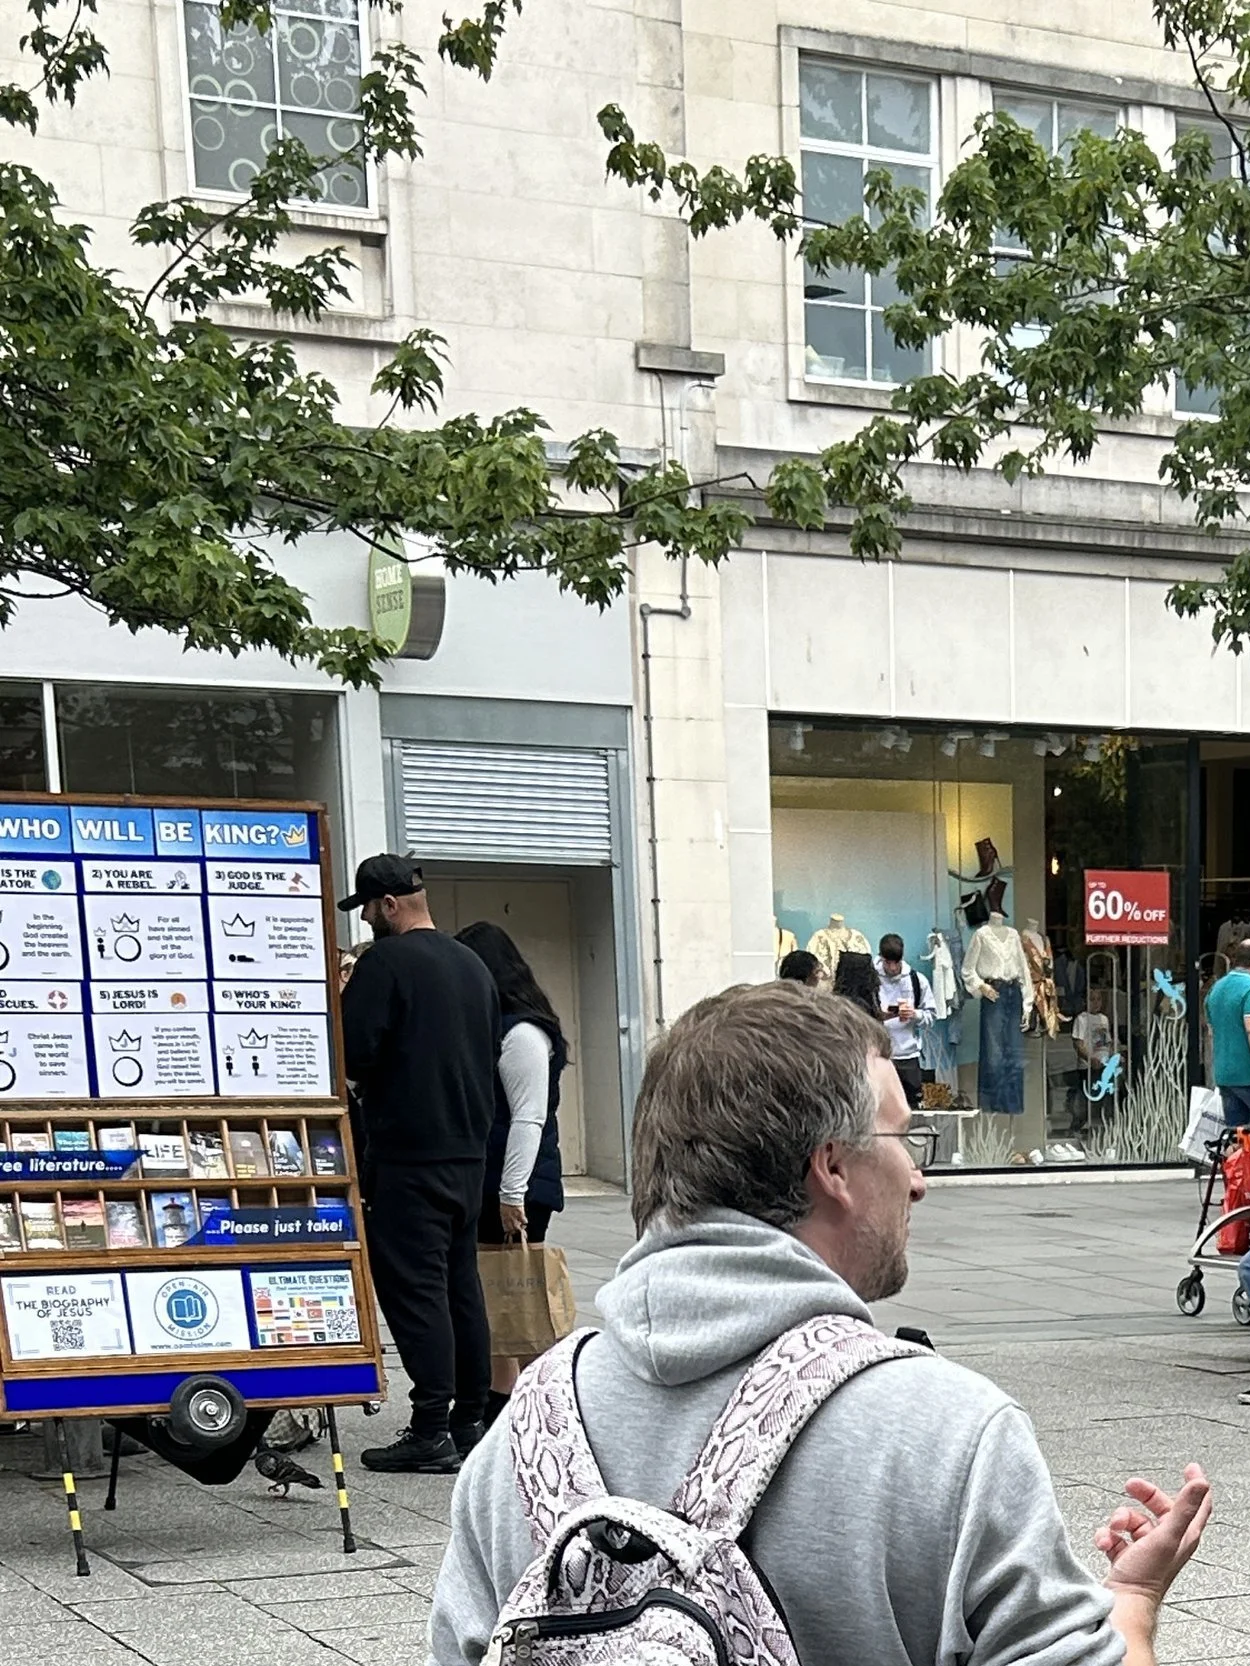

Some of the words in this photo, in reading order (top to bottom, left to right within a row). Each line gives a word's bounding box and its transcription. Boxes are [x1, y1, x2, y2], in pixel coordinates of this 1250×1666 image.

[0, 818, 61, 839] WHO
[76, 819, 144, 841] WILL
[159, 822, 194, 842] BE
[205, 823, 281, 845] KING?
[1, 869, 12, 878] IS
[14, 869, 37, 878] THE
[104, 870, 128, 879] YOU
[130, 870, 153, 879] ARE
[227, 871, 250, 880] GOD
[252, 871, 263, 880] IS
[264, 872, 286, 881] THE
[106, 881, 113, 889] A
[117, 880, 156, 889] REBEL.
[228, 882, 265, 890] JUDGE.
[1088, 890, 1142, 921] 60%
[1143, 910, 1166, 921] OFF
[112, 990, 146, 999] JESUS
[148, 989, 158, 998] IS
[234, 990, 270, 999] WHO'S
[237, 1001, 266, 1009] YOUR
[270, 1000, 302, 1009] KING?
[144, 1144, 185, 1159] LIFE
[274, 1218, 302, 1237] just
[306, 1218, 343, 1232] take!
[46, 1285, 76, 1296] READ
[16, 1300, 38, 1310] THE
[41, 1297, 110, 1309] BIOGRAPHY
[37, 1309, 51, 1319] OF
[57, 1308, 93, 1318] JESUS
